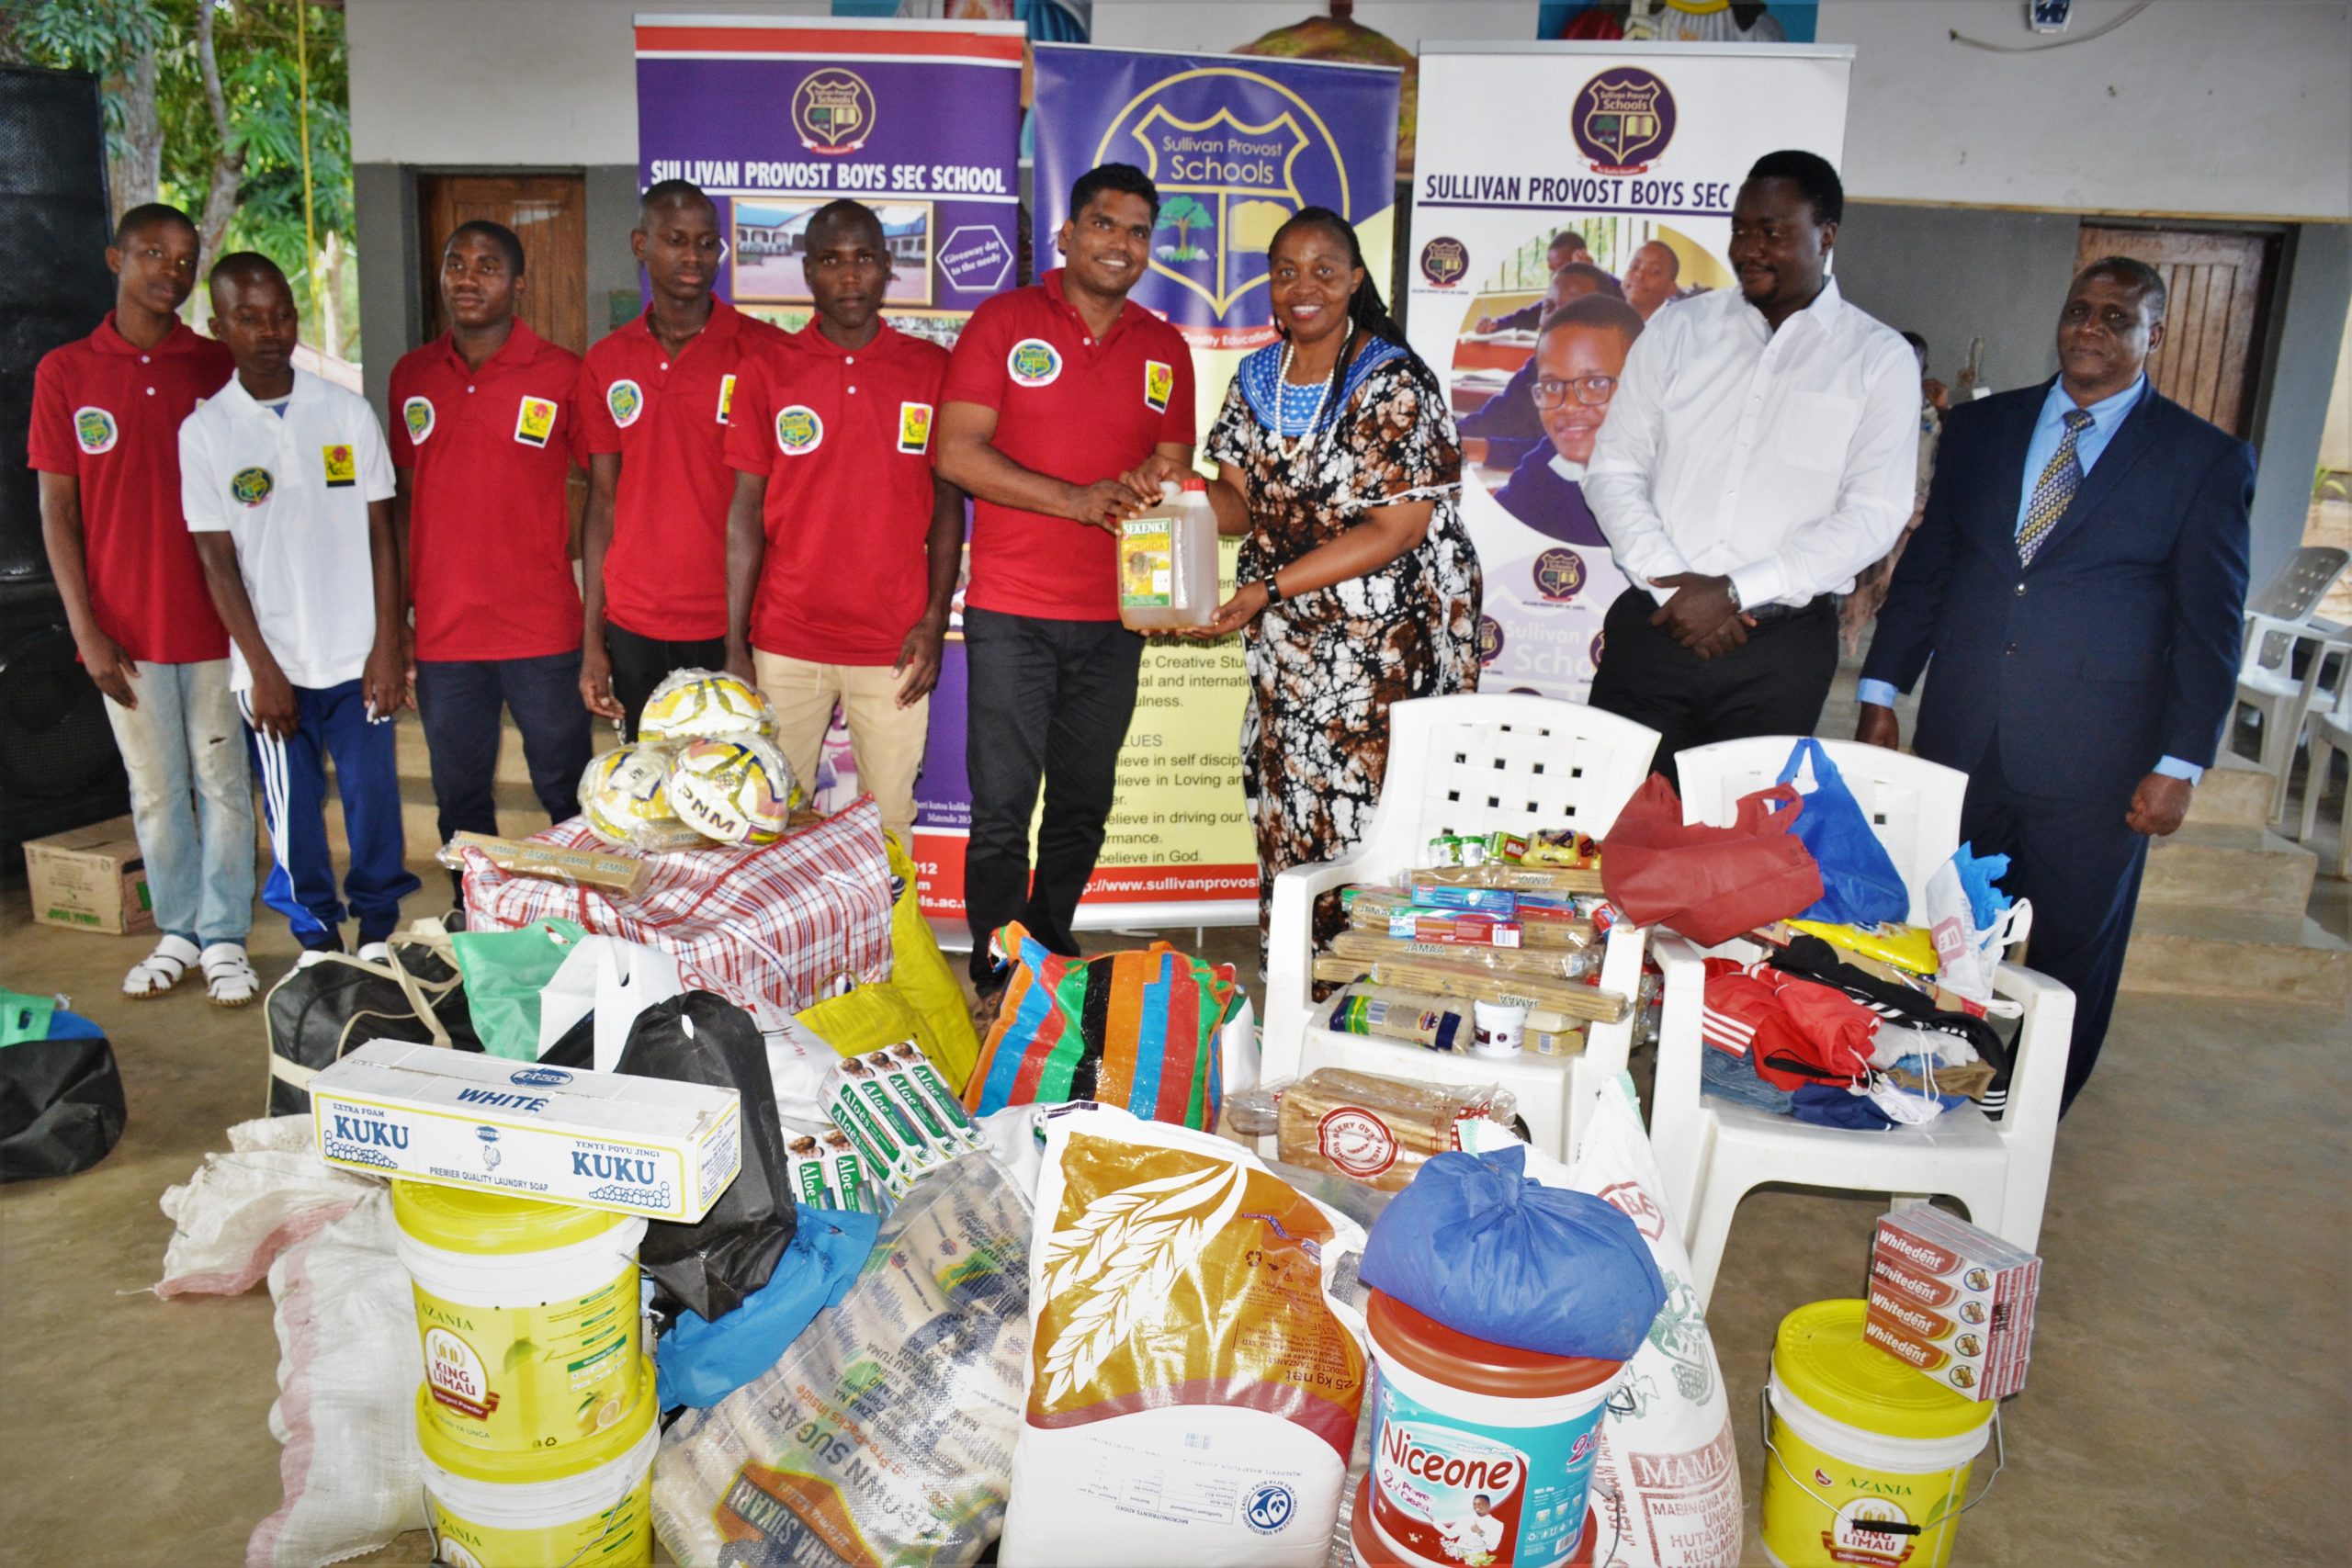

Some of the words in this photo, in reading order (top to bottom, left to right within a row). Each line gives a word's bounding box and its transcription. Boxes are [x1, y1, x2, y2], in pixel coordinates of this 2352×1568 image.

[1602, 99, 1647, 110] Schools
[1163, 136, 1223, 153] Sullivan
[1227, 138, 1282, 156] Provost
[650, 160, 739, 186] SULLIVAN
[745, 162, 831, 188] PROVOST
[837, 164, 887, 189] BOYS
[892, 166, 926, 191] SEC
[932, 166, 1007, 194] SCHOOL
[1170, 155, 1274, 184] Schools
[1426, 175, 1521, 201] SULLIVAN
[1529, 177, 1623, 205] PROVOST
[1631, 180, 1684, 208] BOYS
[1691, 182, 1730, 209] SEC
[961, 262, 976, 272] the
[1222, 331, 1274, 346] Education
[1123, 521, 1169, 535] SEKENKE
[1506, 620, 1580, 643] Sullivan
[1156, 655, 1216, 669] Creative
[1158, 675, 1184, 687] and
[1154, 755, 1166, 767] in
[1170, 753, 1195, 766] self
[1156, 774, 1168, 786] in
[1175, 774, 1221, 788] Loving
[1153, 813, 1165, 824] in
[1170, 812, 1216, 826] driving
[1221, 813, 1243, 823] our
[1152, 852, 1165, 863] in
[1170, 850, 1203, 863] God.
[1404, 943, 1446, 955] JAMAA
[1498, 994, 1541, 1009] JAMAA
[890, 1075, 917, 1105] Aloe
[912, 1066, 940, 1095] Aloe
[457, 1089, 549, 1112] WHITE
[842, 1089, 871, 1127] Aloès
[863, 1082, 889, 1113] Aloe
[334, 1103, 359, 1115] EXTRA
[361, 1108, 385, 1117] FOAM
[334, 1114, 409, 1150] KUKU
[833, 1109, 861, 1147] Aloès
[576, 1140, 606, 1151] YENYE
[607, 1145, 633, 1155] POVU
[635, 1148, 660, 1158] JINGI
[429, 1167, 460, 1179] PREMIER
[462, 1171, 492, 1184] QUALITY
[494, 1176, 527, 1190] LAUNDRY
[529, 1181, 548, 1191] SOAP
[571, 1151, 655, 1185] KUKU
[837, 1157, 853, 1190] Aloe
[800, 1165, 817, 1197] Aloe
[1879, 1230, 1943, 1269] Whitedent
[1875, 1261, 1939, 1301] Whitedent
[422, 1303, 474, 1331] AZANIA
[1871, 1292, 1935, 1332] Whitedent
[1866, 1323, 1929, 1363] Whitedent
[433, 1369, 476, 1395] LIMAU
[435, 1359, 469, 1382] KING
[1284, 1369, 1313, 1385] net
[1315, 1372, 1333, 1388] kg
[1334, 1378, 1351, 1392] 25
[459, 1400, 483, 1416] Powder
[792, 1382, 831, 1418] inside
[763, 1392, 852, 1472] SUGAR
[1382, 1417, 1514, 1490] Niceone
[1847, 1477, 1912, 1495] AZANIA
[725, 1475, 803, 1549] SUKARI
[1842, 1533, 1896, 1551] LIMAU
[1837, 1551, 1871, 1562] Detergent
[1871, 1557, 1897, 1567] Powder
